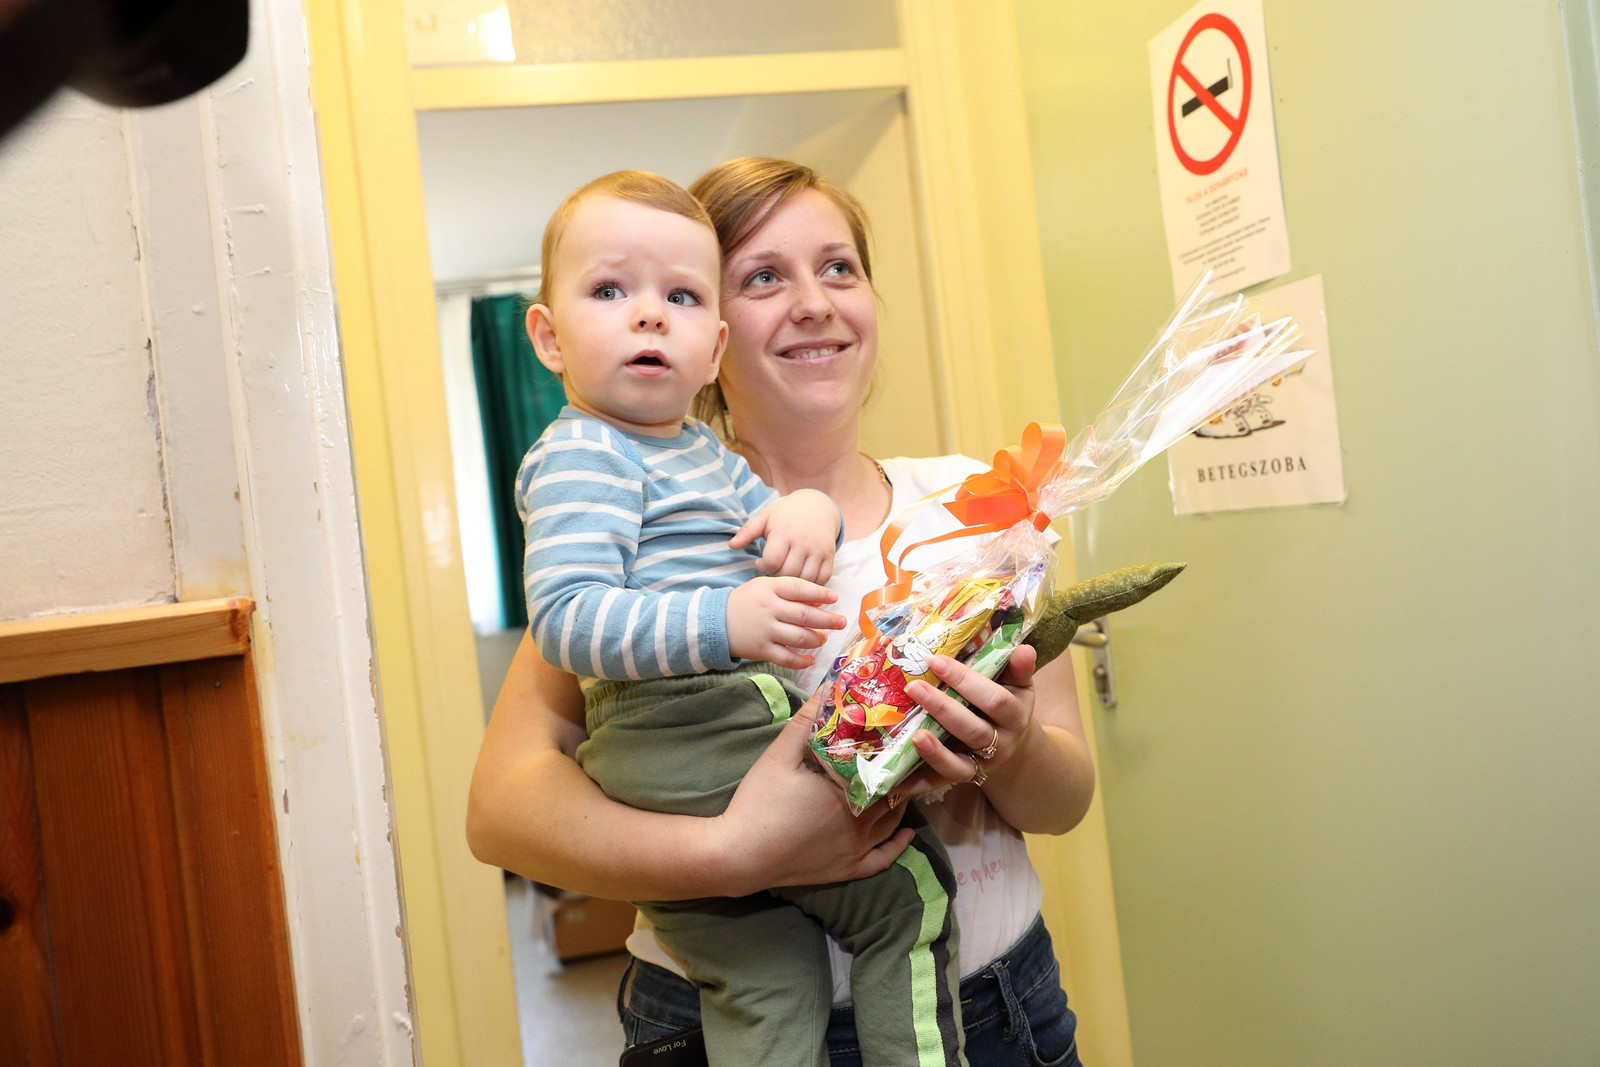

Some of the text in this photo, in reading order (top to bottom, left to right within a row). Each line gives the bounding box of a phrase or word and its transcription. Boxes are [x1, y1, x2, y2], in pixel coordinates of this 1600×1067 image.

[1197, 456, 1307, 483] BETEGSZOBA
[653, 1039, 686, 1054] For Love
